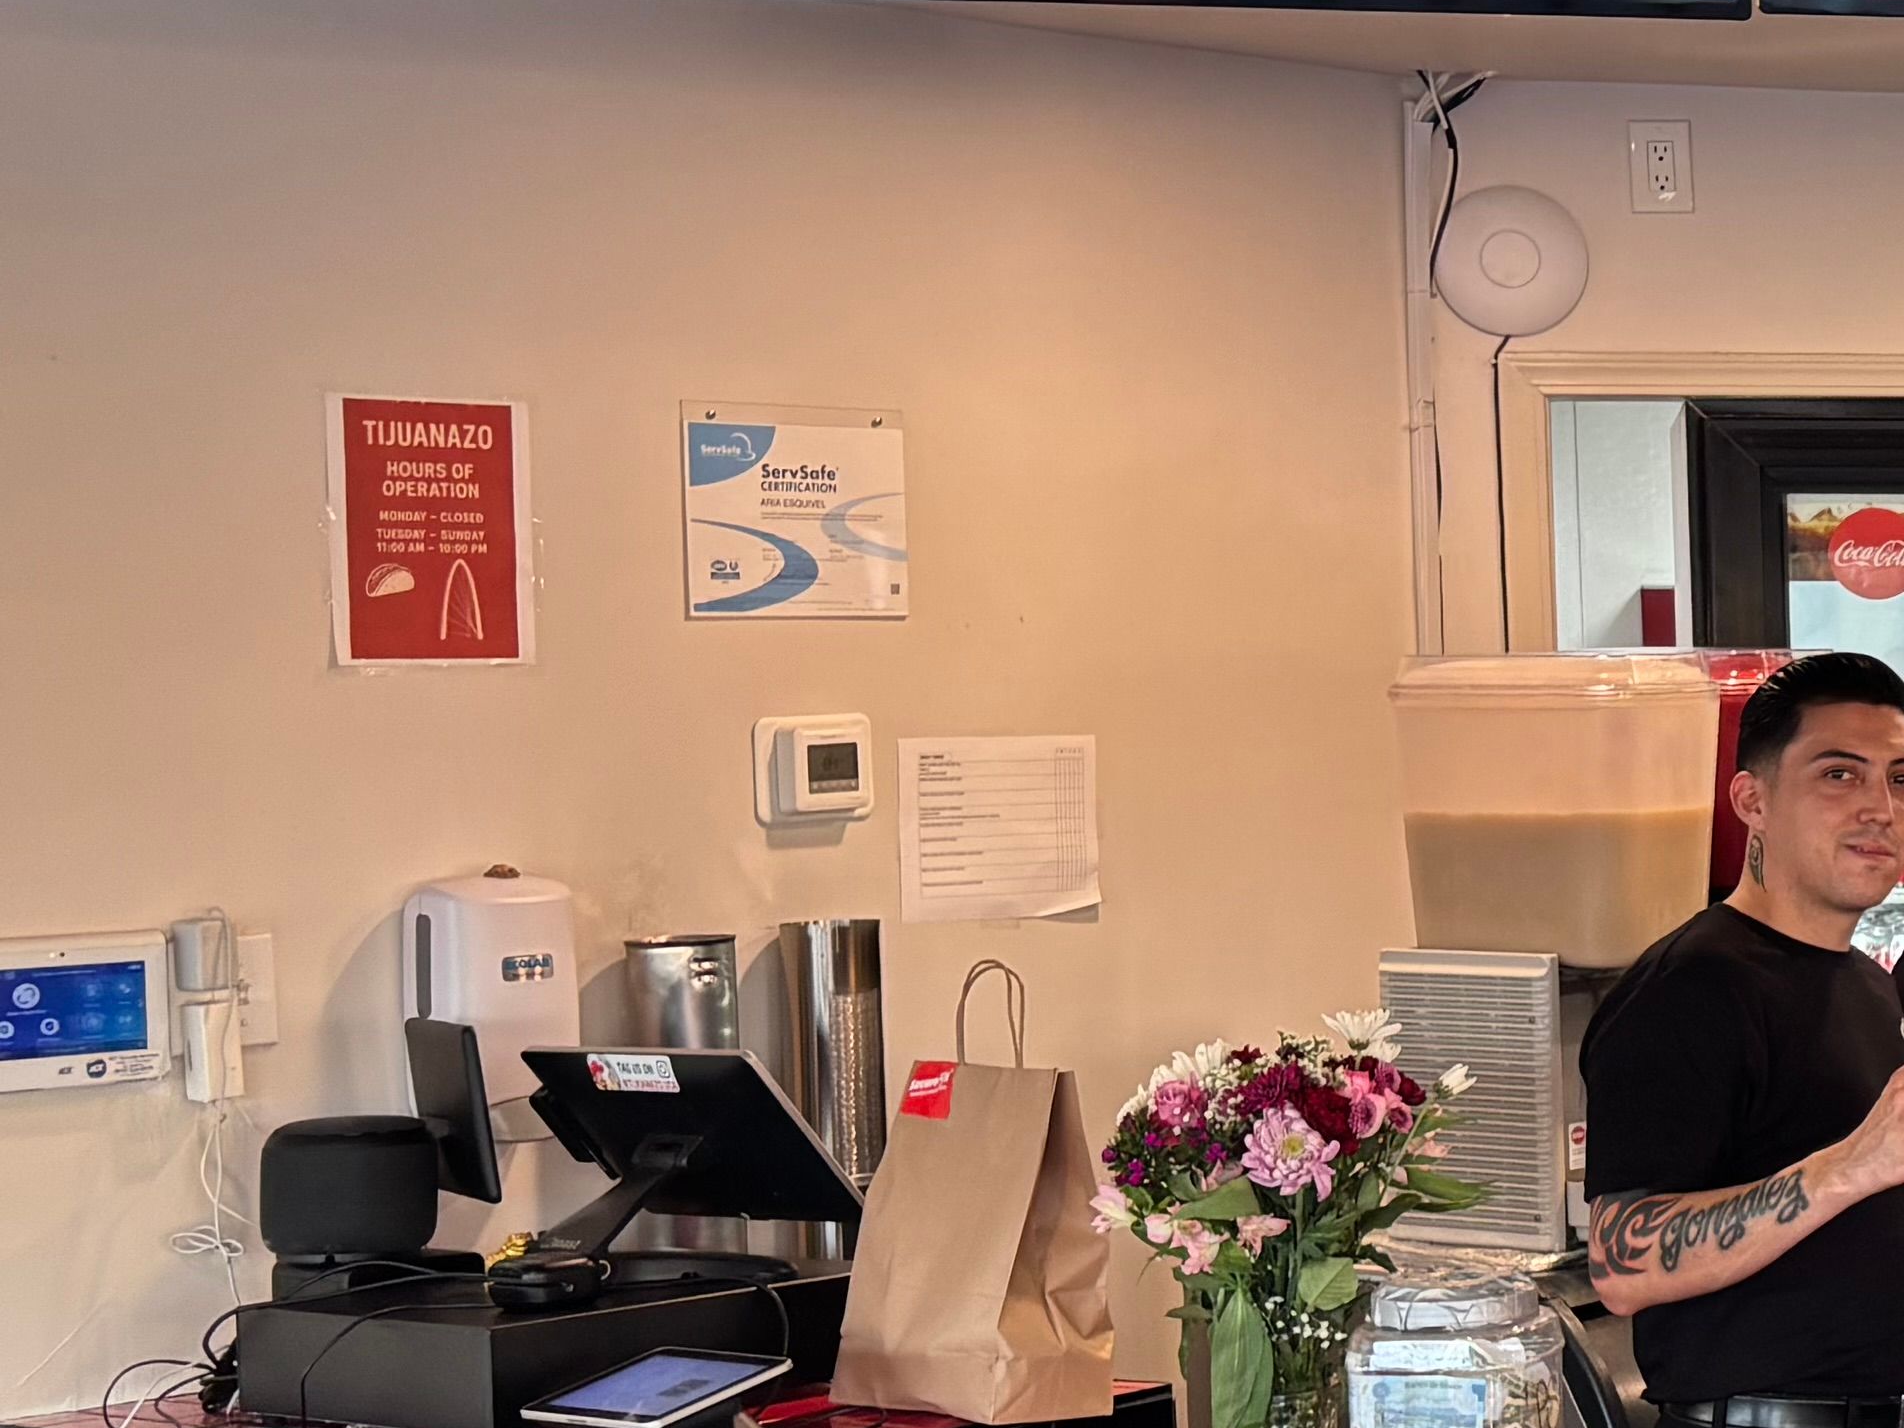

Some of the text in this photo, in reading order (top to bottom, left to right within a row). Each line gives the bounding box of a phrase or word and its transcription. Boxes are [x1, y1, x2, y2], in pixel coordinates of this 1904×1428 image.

[362, 420, 493, 449] TIJUANAZO
[700, 444, 741, 455] ServSafe
[386, 461, 474, 479] HOURS OF
[383, 480, 479, 499] OPERATION
[761, 481, 837, 493] CERTIFICATION
[379, 510, 484, 523] MONDAY CLOSED
[377, 529, 485, 540] TUESDAY SUNDAY
[377, 542, 487, 553] 11:00 AM 10:00 PM
